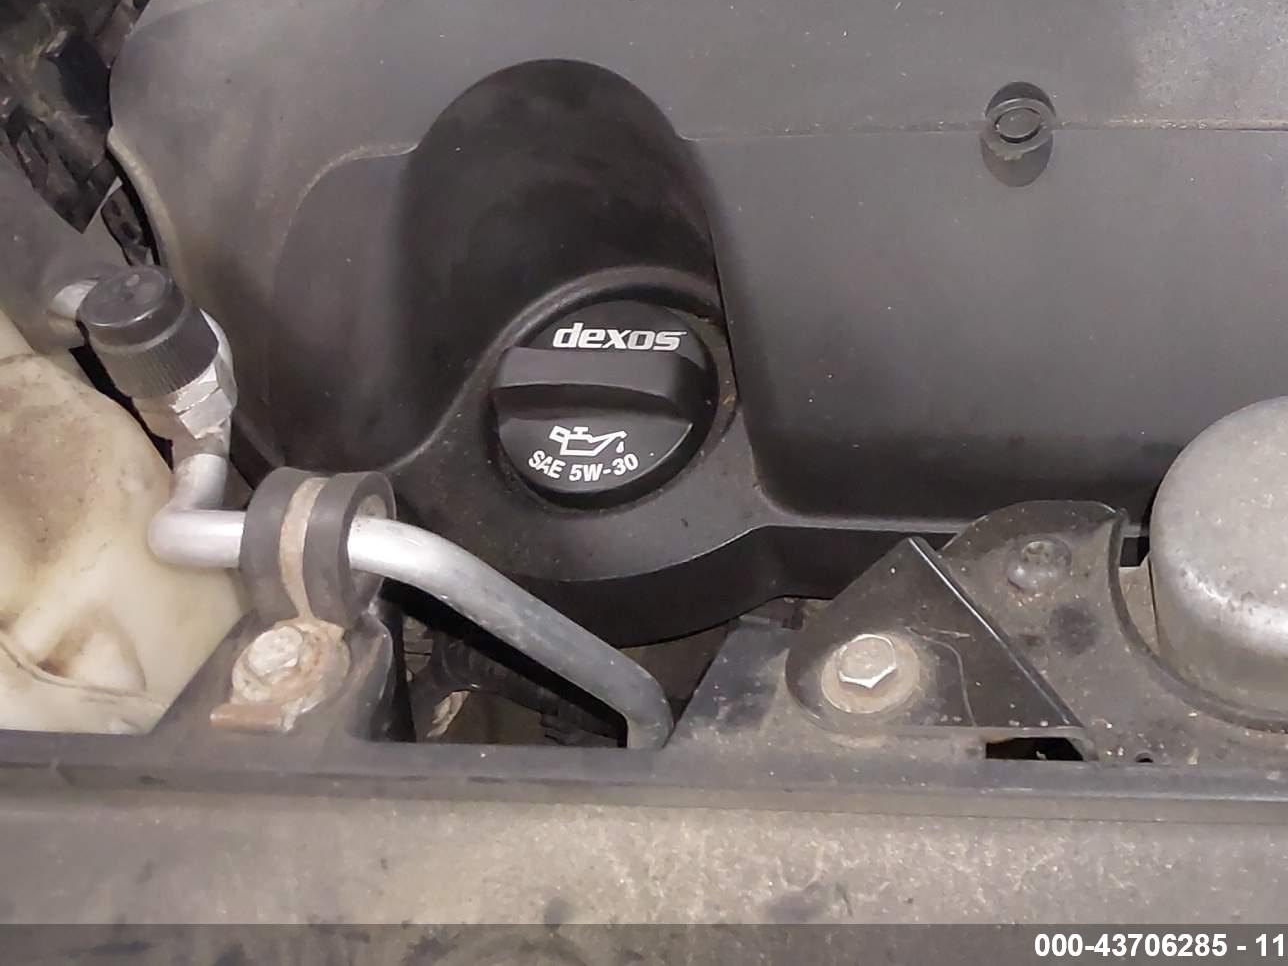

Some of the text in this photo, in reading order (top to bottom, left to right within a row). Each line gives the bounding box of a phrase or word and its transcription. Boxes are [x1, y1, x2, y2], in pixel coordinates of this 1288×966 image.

[553, 323, 687, 351] dexos
[528, 450, 639, 481] SAE 5W-30
